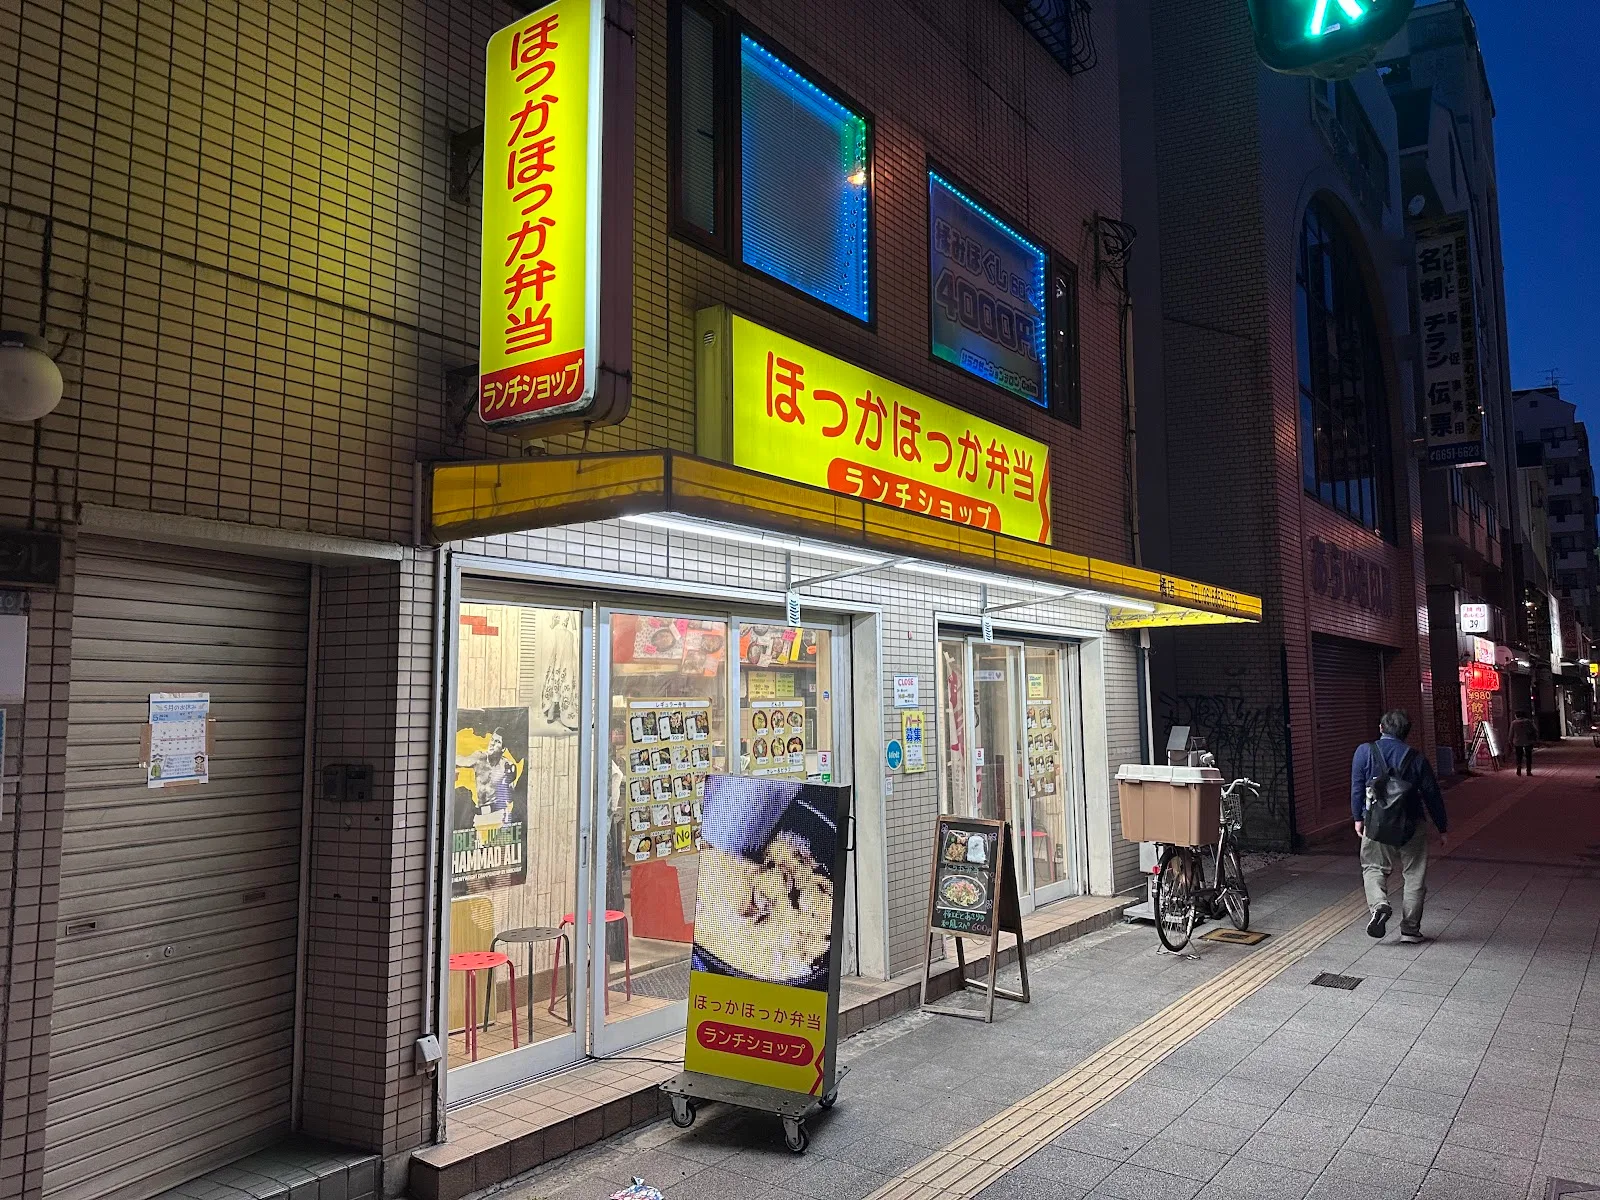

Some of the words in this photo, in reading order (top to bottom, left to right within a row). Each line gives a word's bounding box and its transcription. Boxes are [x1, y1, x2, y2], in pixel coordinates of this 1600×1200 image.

[504, 13, 559, 355] ほっかほっか弁当
[483, 359, 583, 413] ランチショップ
[766, 350, 1034, 503] ほっかほっか弁当
[845, 467, 992, 529] ランチショップ
[898, 678, 914, 687] CLOSE
[906, 727, 922, 743] 募集
[504, 843, 522, 866] ALI
[676, 830, 690, 846] No
[693, 994, 821, 1031] ほっかほっか弁当
[704, 1027, 806, 1059] ランチショップ
